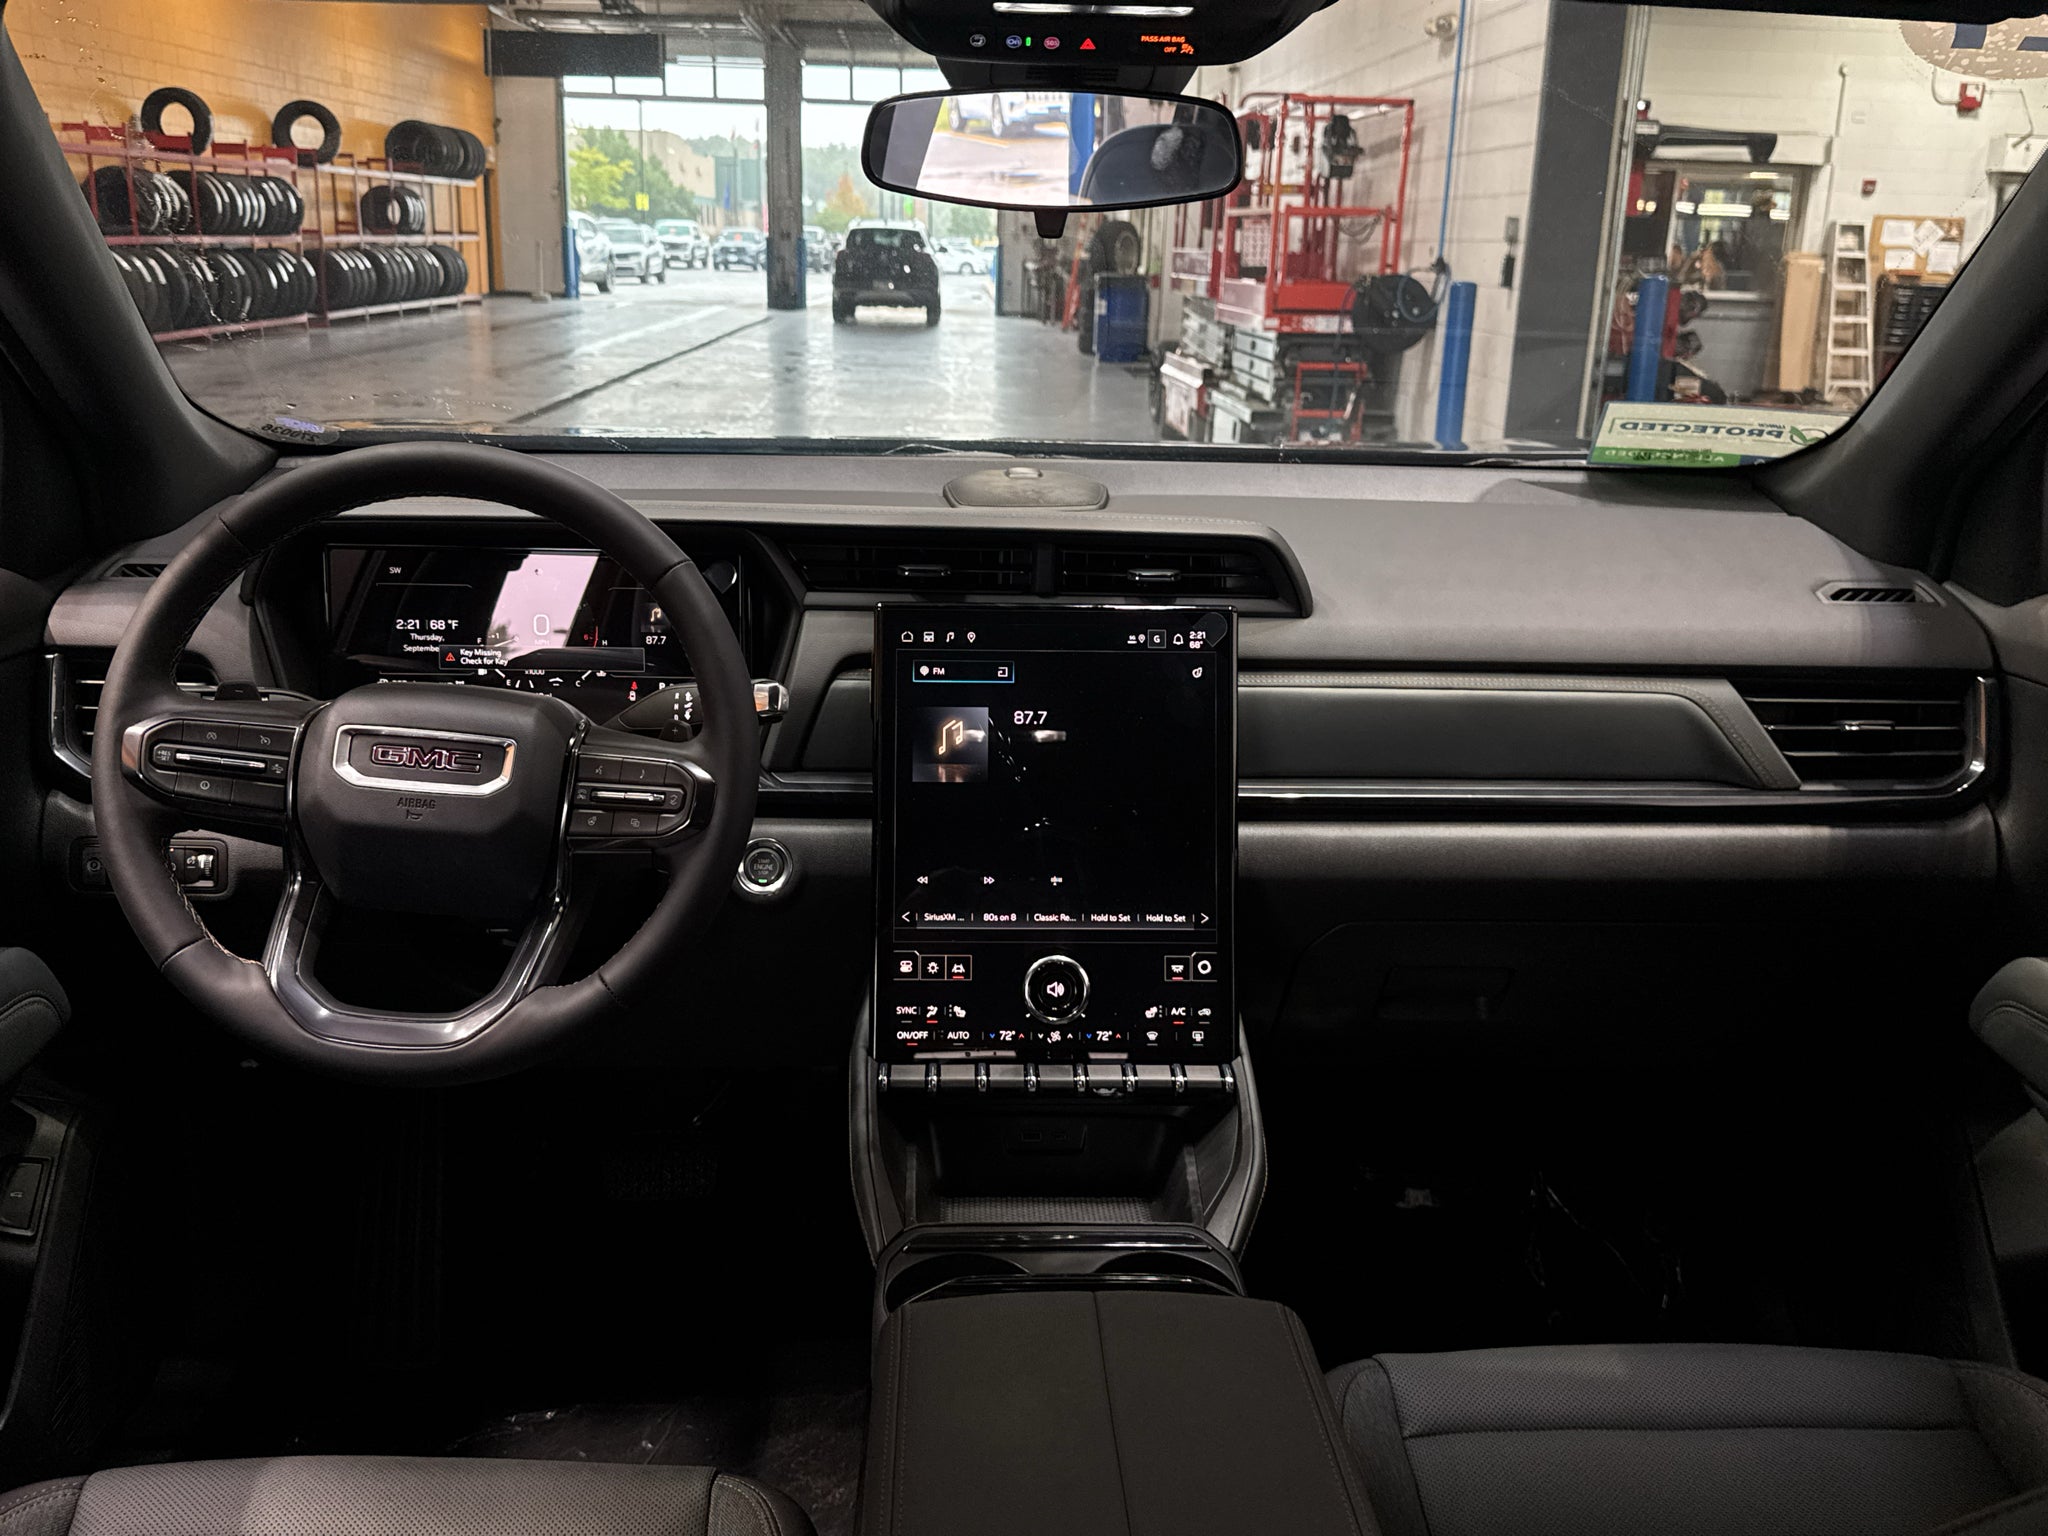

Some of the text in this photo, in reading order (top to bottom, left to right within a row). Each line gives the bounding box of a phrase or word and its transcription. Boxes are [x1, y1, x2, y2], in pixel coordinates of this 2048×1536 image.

[396, 619, 420, 630] 2:21
[430, 619, 446, 630] 68
[533, 614, 550, 636] 0
[410, 633, 445, 642] Thursday,
[1153, 635, 1160, 643] G
[1189, 631, 1206, 639] 2:21
[645, 635, 667, 645] 87.7
[403, 644, 440, 653] Septembe
[1189, 641, 1203, 649] 68°
[459, 648, 502, 657] Key Missing
[460, 657, 509, 667] Check for Key
[932, 667, 945, 675] FM
[1013, 710, 1048, 725] 87.7
[372, 745, 482, 773] GMC
[397, 797, 436, 809] AIRBAG
[924, 912, 956, 921] SiriusXM
[983, 913, 998, 921] 80s
[1010, 913, 1017, 921] 8
[1033, 913, 1059, 922] Classic
[1091, 913, 1131, 922] Hold to Set
[1146, 914, 1186, 922] Hold to Set
[896, 1006, 917, 1015] SYNC
[1171, 1007, 1186, 1016] A/C
[896, 1030, 929, 1040] ON/OFF
[947, 1031, 970, 1040] AUTO
[999, 1030, 1016, 1041] 72°
[1096, 1030, 1112, 1041] 72°
